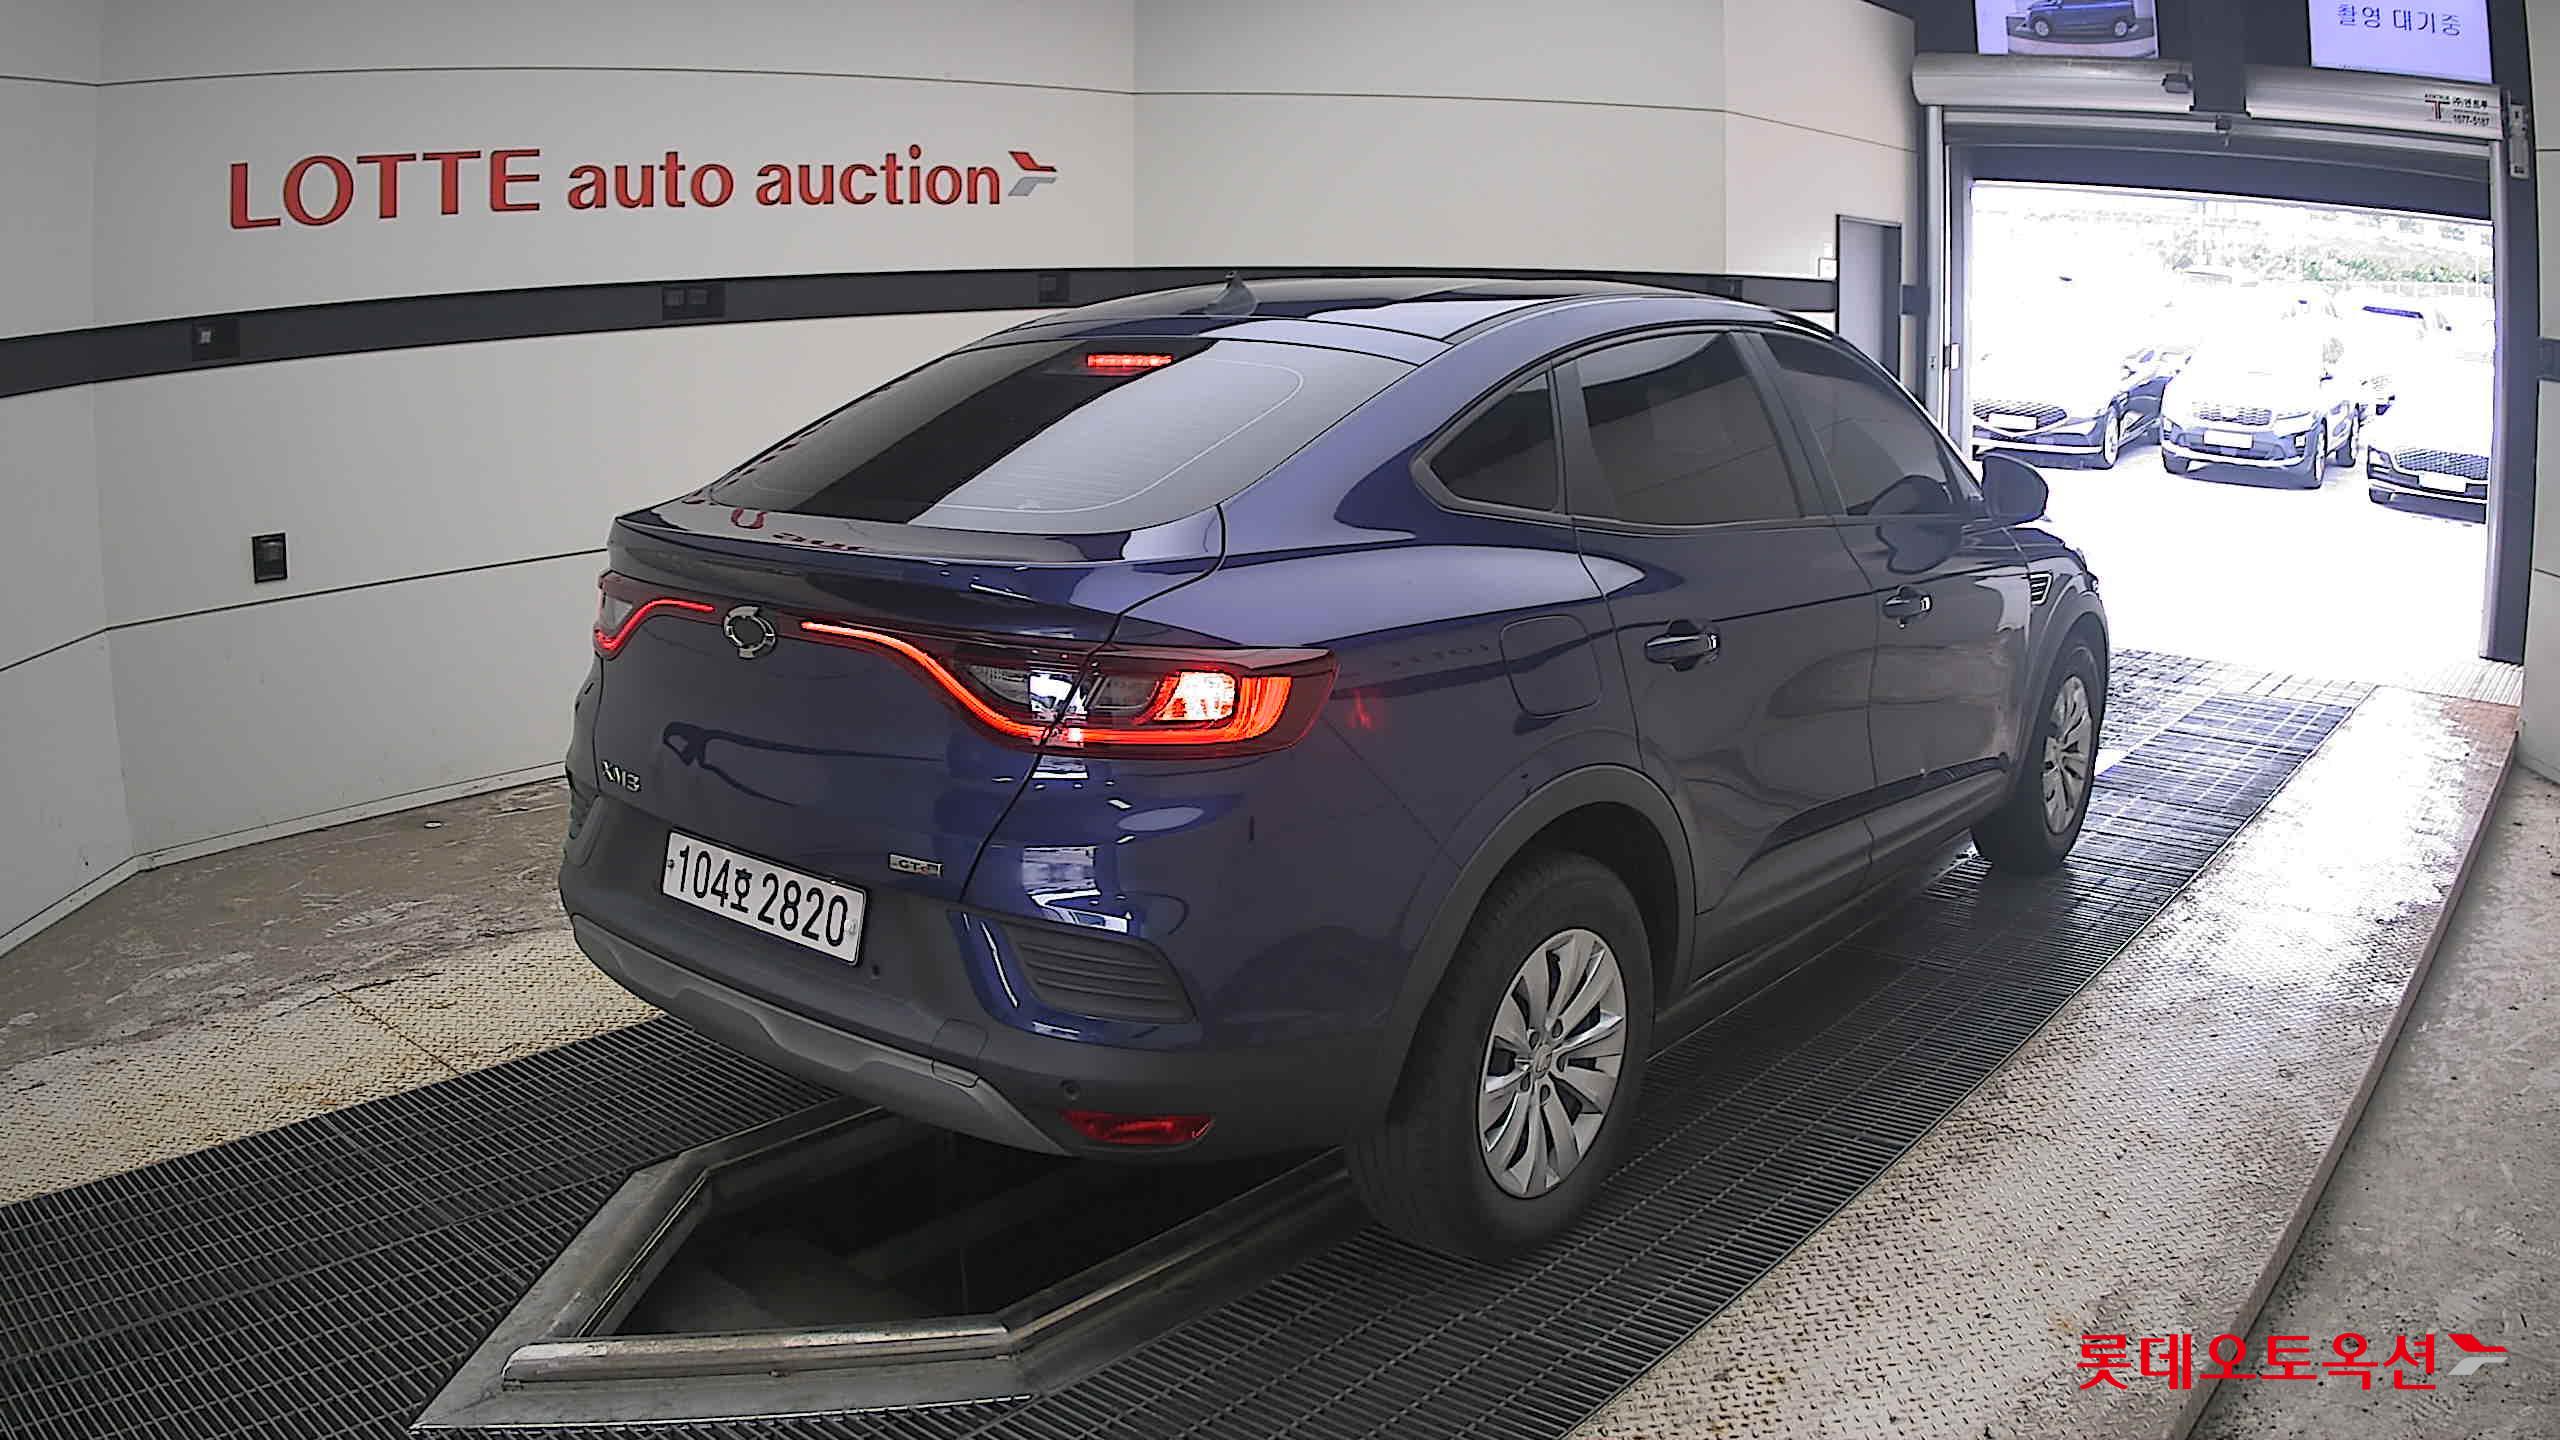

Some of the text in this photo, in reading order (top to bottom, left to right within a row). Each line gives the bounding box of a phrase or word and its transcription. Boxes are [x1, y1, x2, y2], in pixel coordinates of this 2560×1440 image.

[2337, 3, 2462, 37] 촬영 대기중
[229, 144, 1001, 231] LOTTE auto auction
[678, 844, 850, 948] 104호 2820
